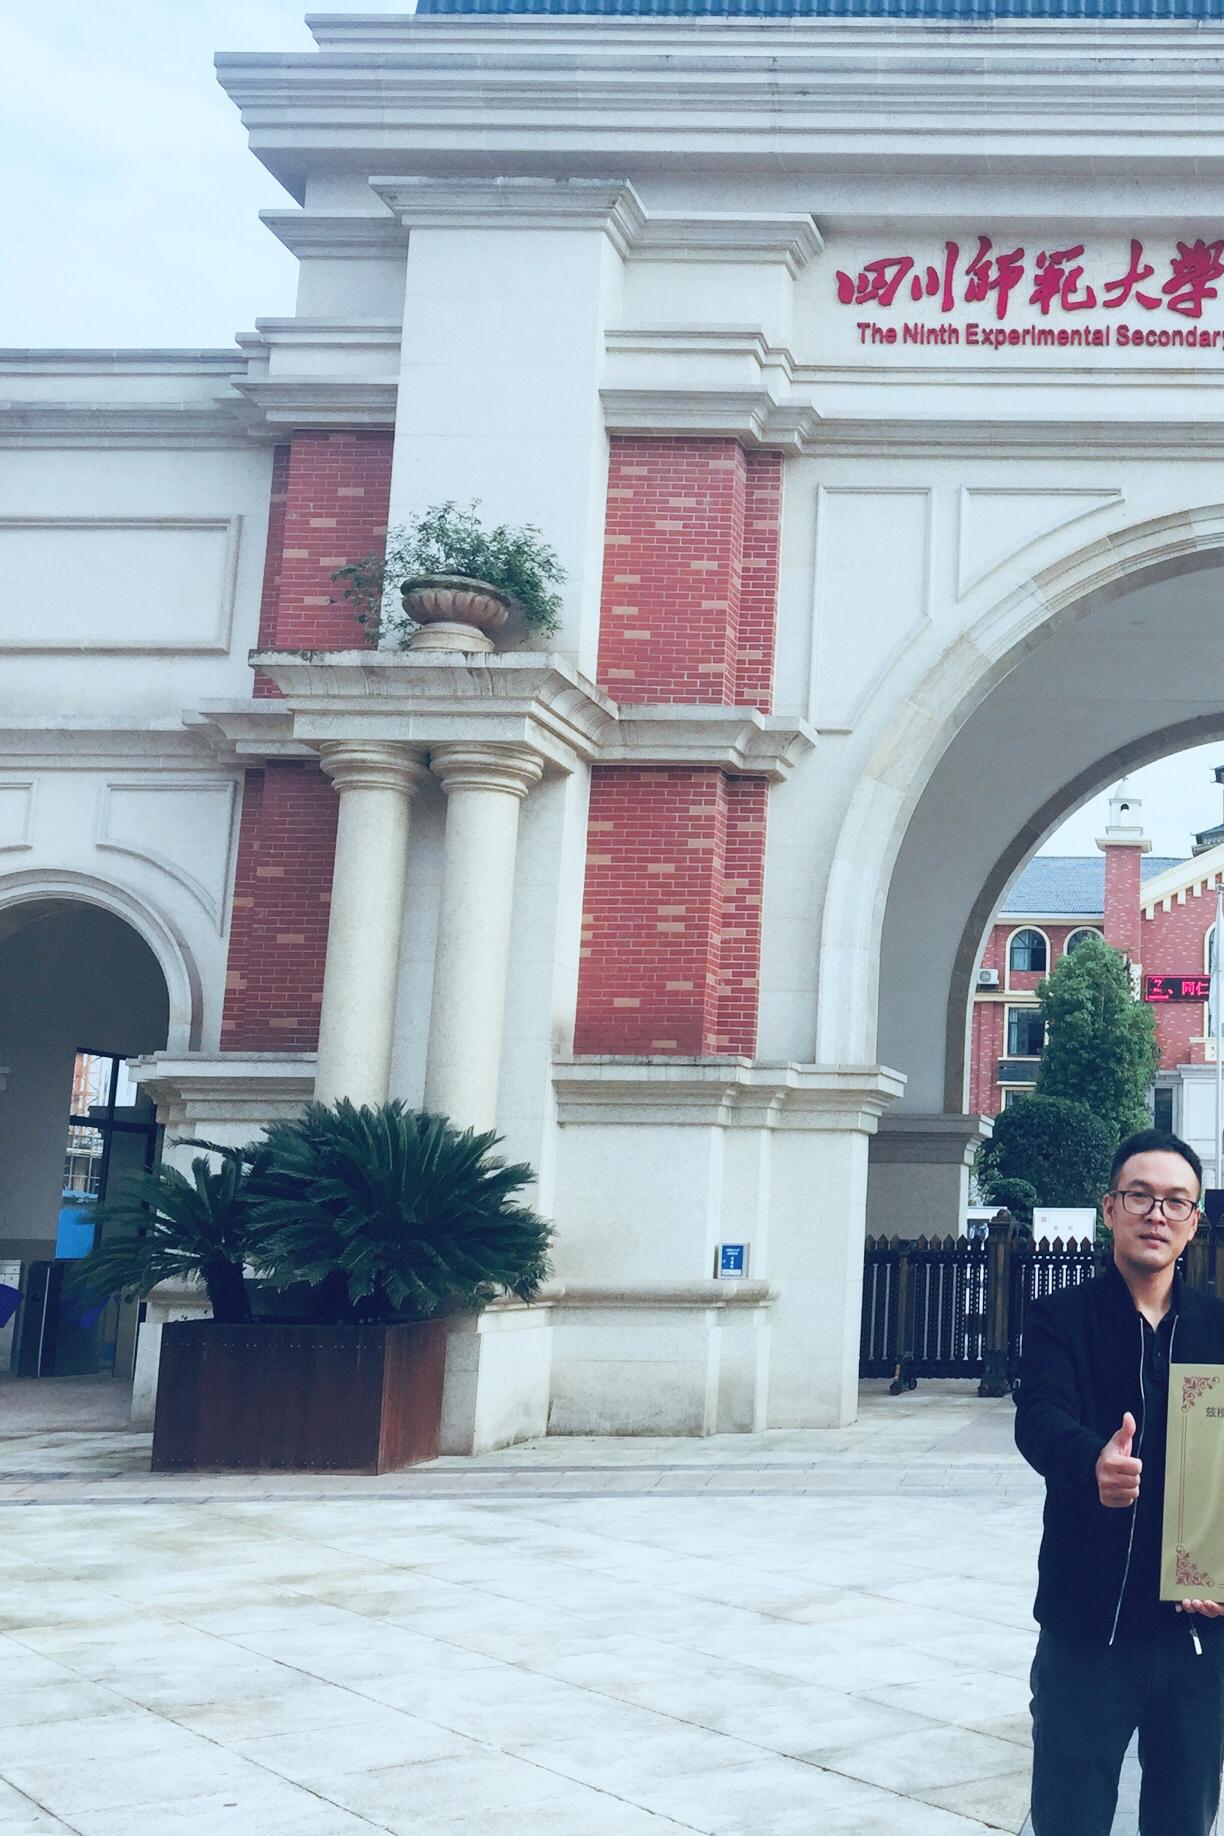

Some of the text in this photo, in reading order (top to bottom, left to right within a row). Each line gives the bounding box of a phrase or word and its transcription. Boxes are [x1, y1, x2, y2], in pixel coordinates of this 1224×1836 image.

[857, 322, 898, 345] The
[903, 322, 961, 346] Ninth
[966, 323, 1111, 351] Experimental
